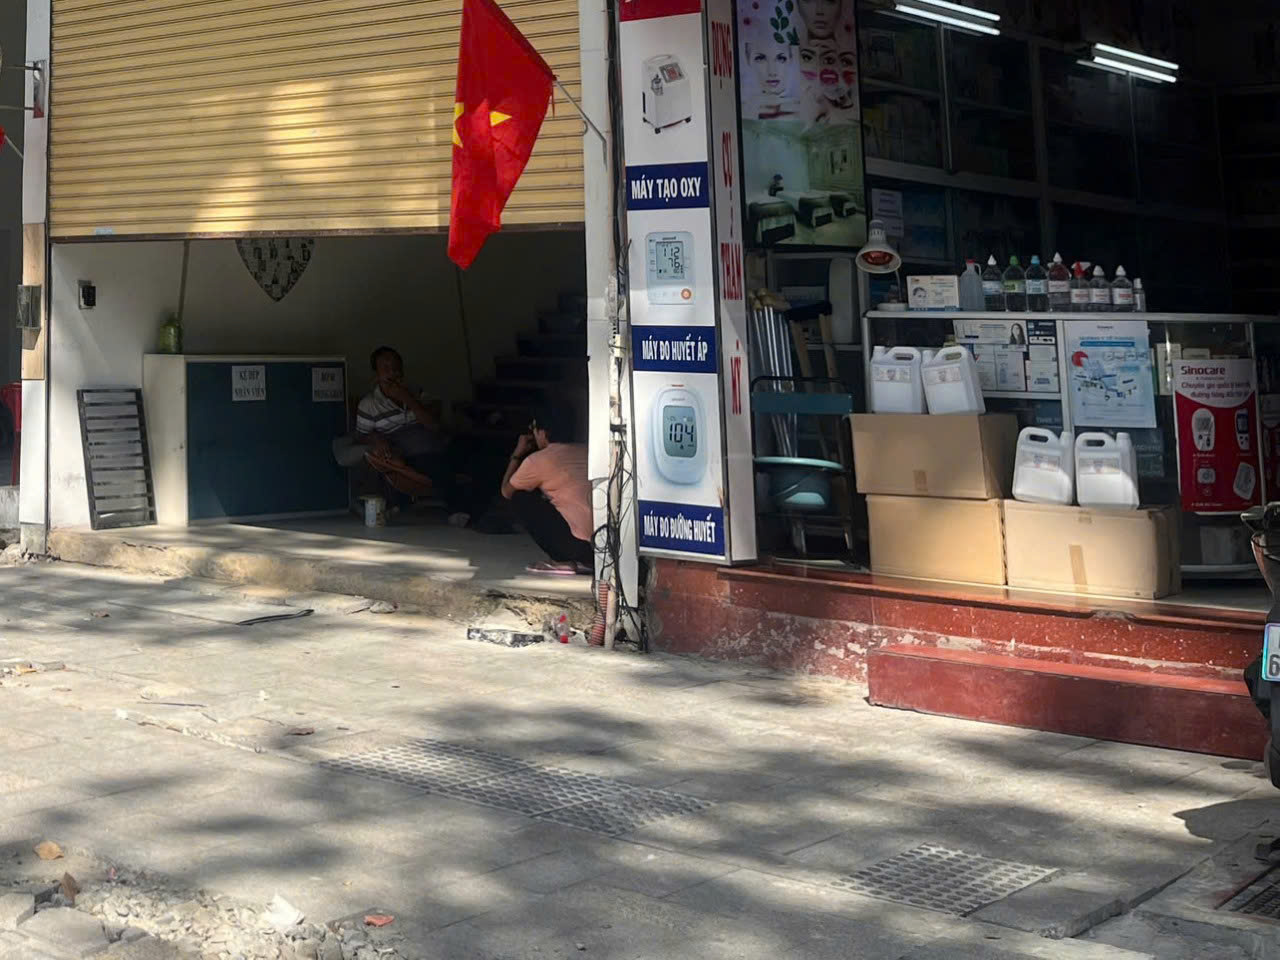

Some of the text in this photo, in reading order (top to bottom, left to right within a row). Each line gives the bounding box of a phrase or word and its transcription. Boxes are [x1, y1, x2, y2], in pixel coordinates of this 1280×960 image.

[631, 174, 701, 202] MÁY TẠO OXY
[642, 334, 658, 360] MÁY
[671, 333, 696, 361] HUYẾT
[697, 336, 708, 361] ÁP
[1181, 366, 1225, 375] Sinocare
[669, 423, 694, 443] 104
[644, 509, 658, 537] MÁY
[693, 512, 716, 543] HUYẾT
